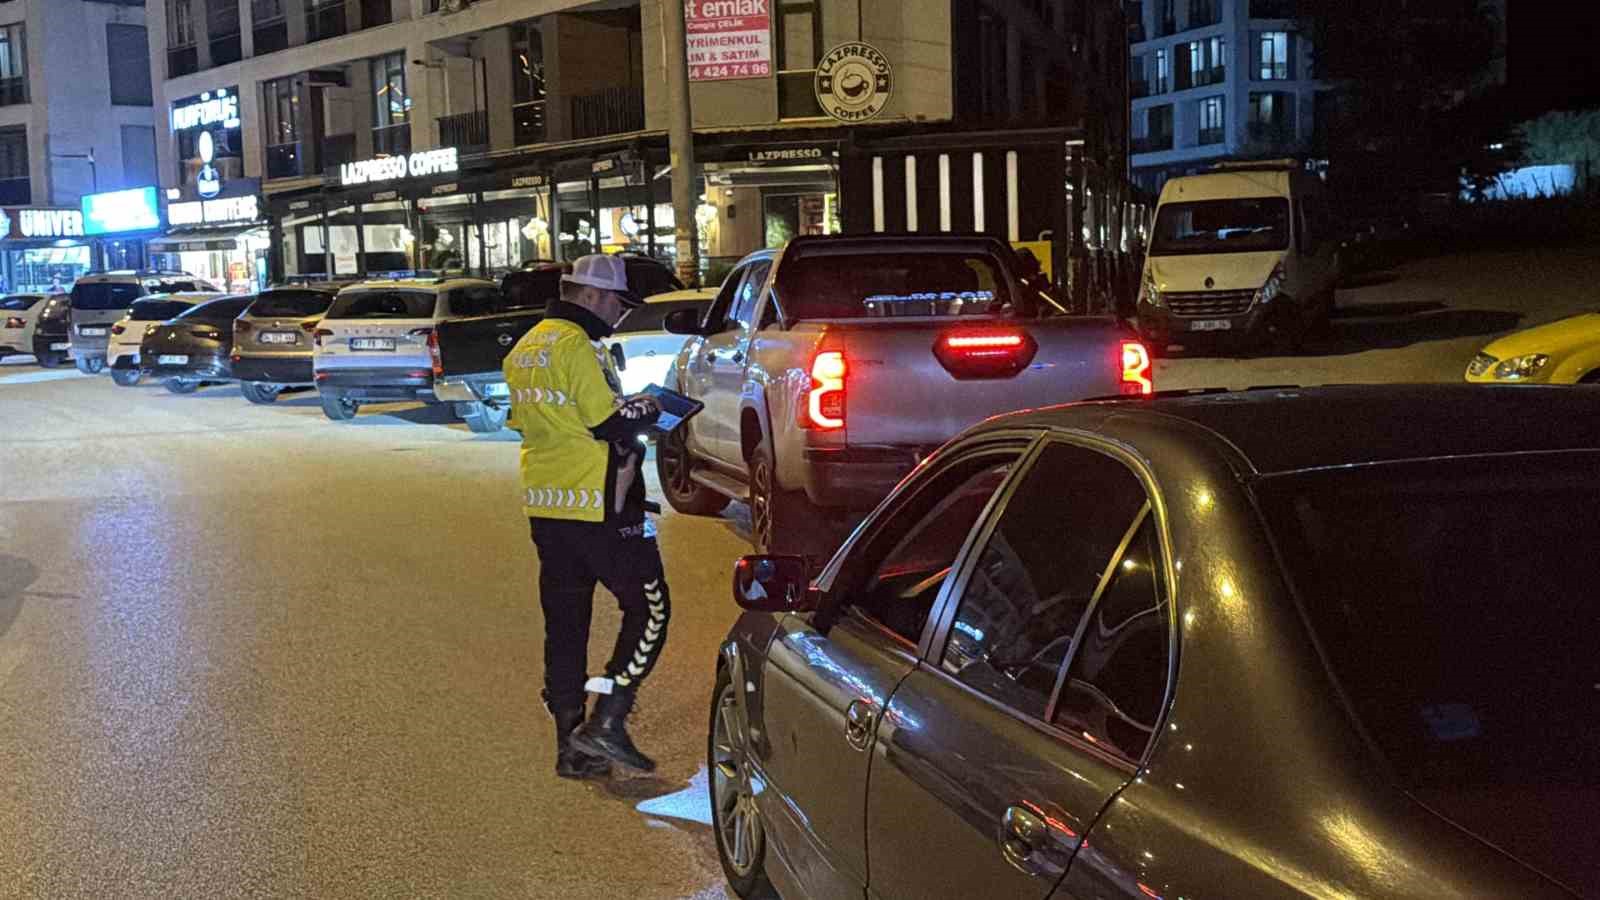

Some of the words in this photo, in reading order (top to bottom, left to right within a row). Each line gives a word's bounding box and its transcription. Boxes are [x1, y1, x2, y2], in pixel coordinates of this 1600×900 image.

[702, 0, 766, 18] emlak
[686, 34, 762, 49] YRİMENKUL
[686, 52, 705, 63] IM
[709, 52, 718, 62] &
[720, 49, 760, 61] SATIM
[821, 46, 889, 74] LAZPRESSO
[704, 65, 729, 78] 424
[731, 64, 749, 76] 74
[833, 105, 876, 120] COFFEE
[749, 148, 822, 161] LAZPRESSO
[341, 155, 407, 185] LAZPRESSO
[408, 147, 458, 176] COFFEE
